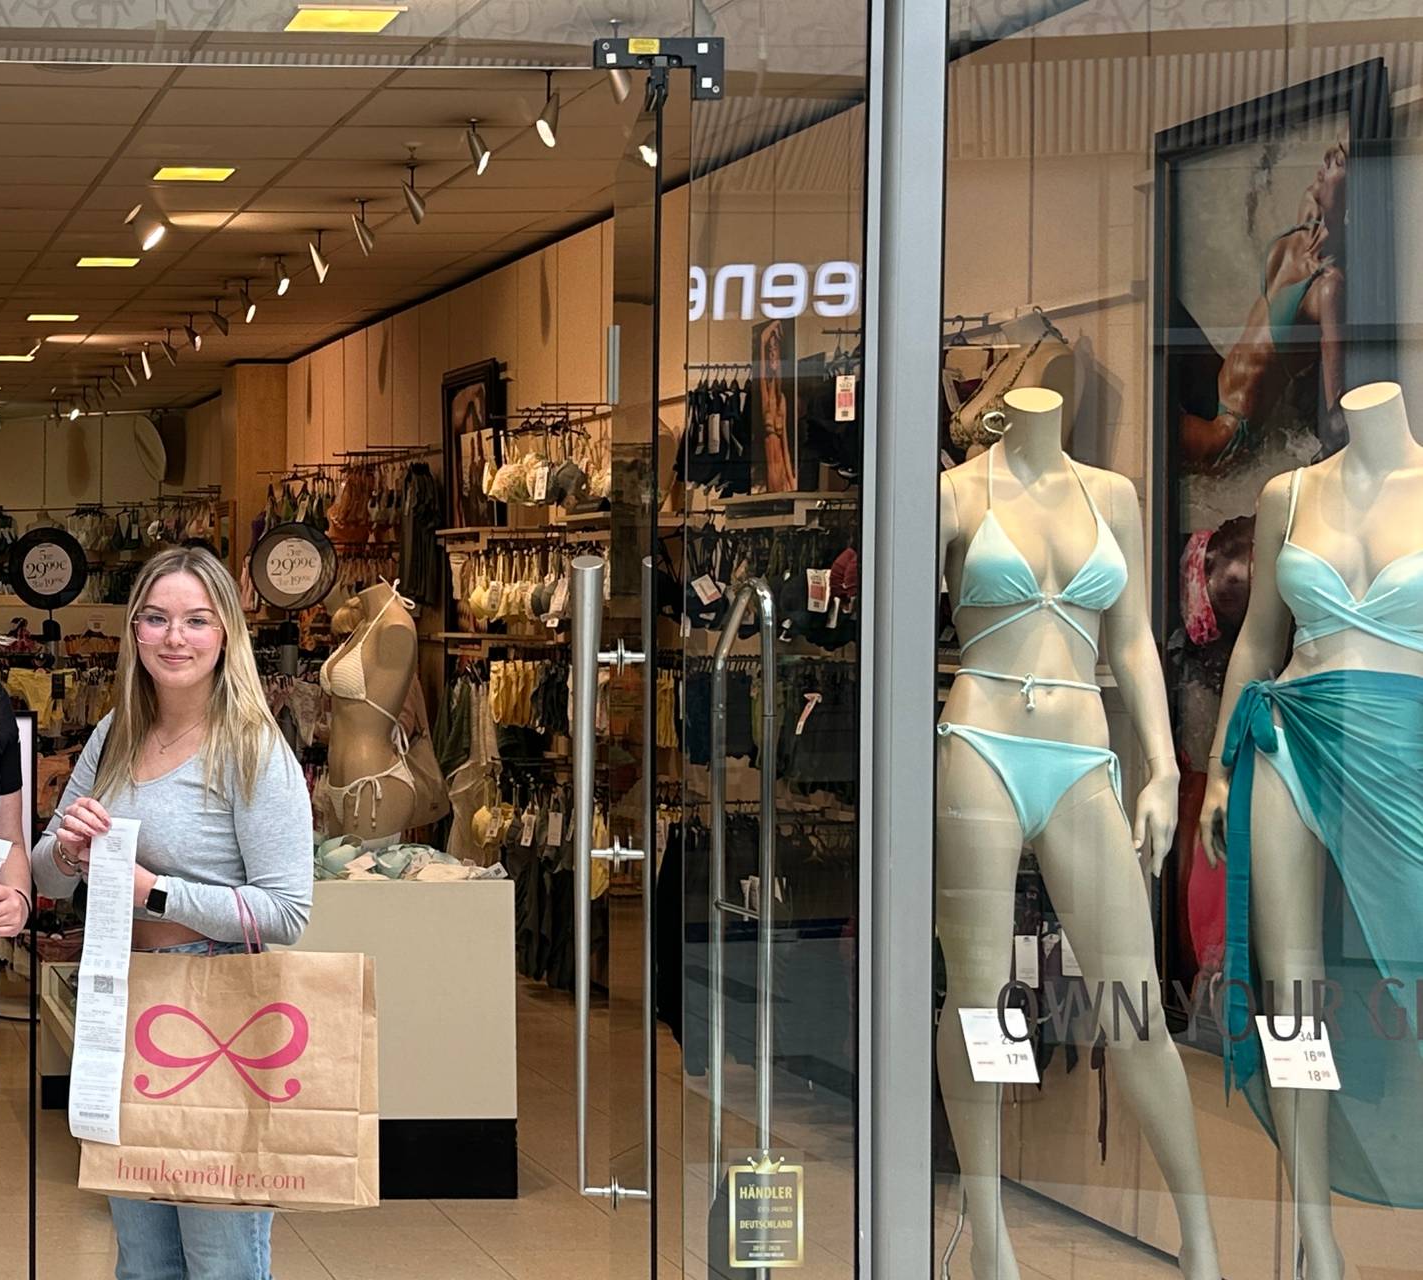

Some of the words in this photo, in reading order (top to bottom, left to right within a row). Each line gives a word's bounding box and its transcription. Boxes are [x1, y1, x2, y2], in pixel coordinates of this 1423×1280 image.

[997, 980, 1149, 1042] OWN
[1171, 979, 1346, 1042] YOUR
[117, 1157, 306, 1190] hunkemöller.com
[739, 1184, 793, 1200] HÄNDLER
[739, 1219, 794, 1230] DEUTSCHLAND
